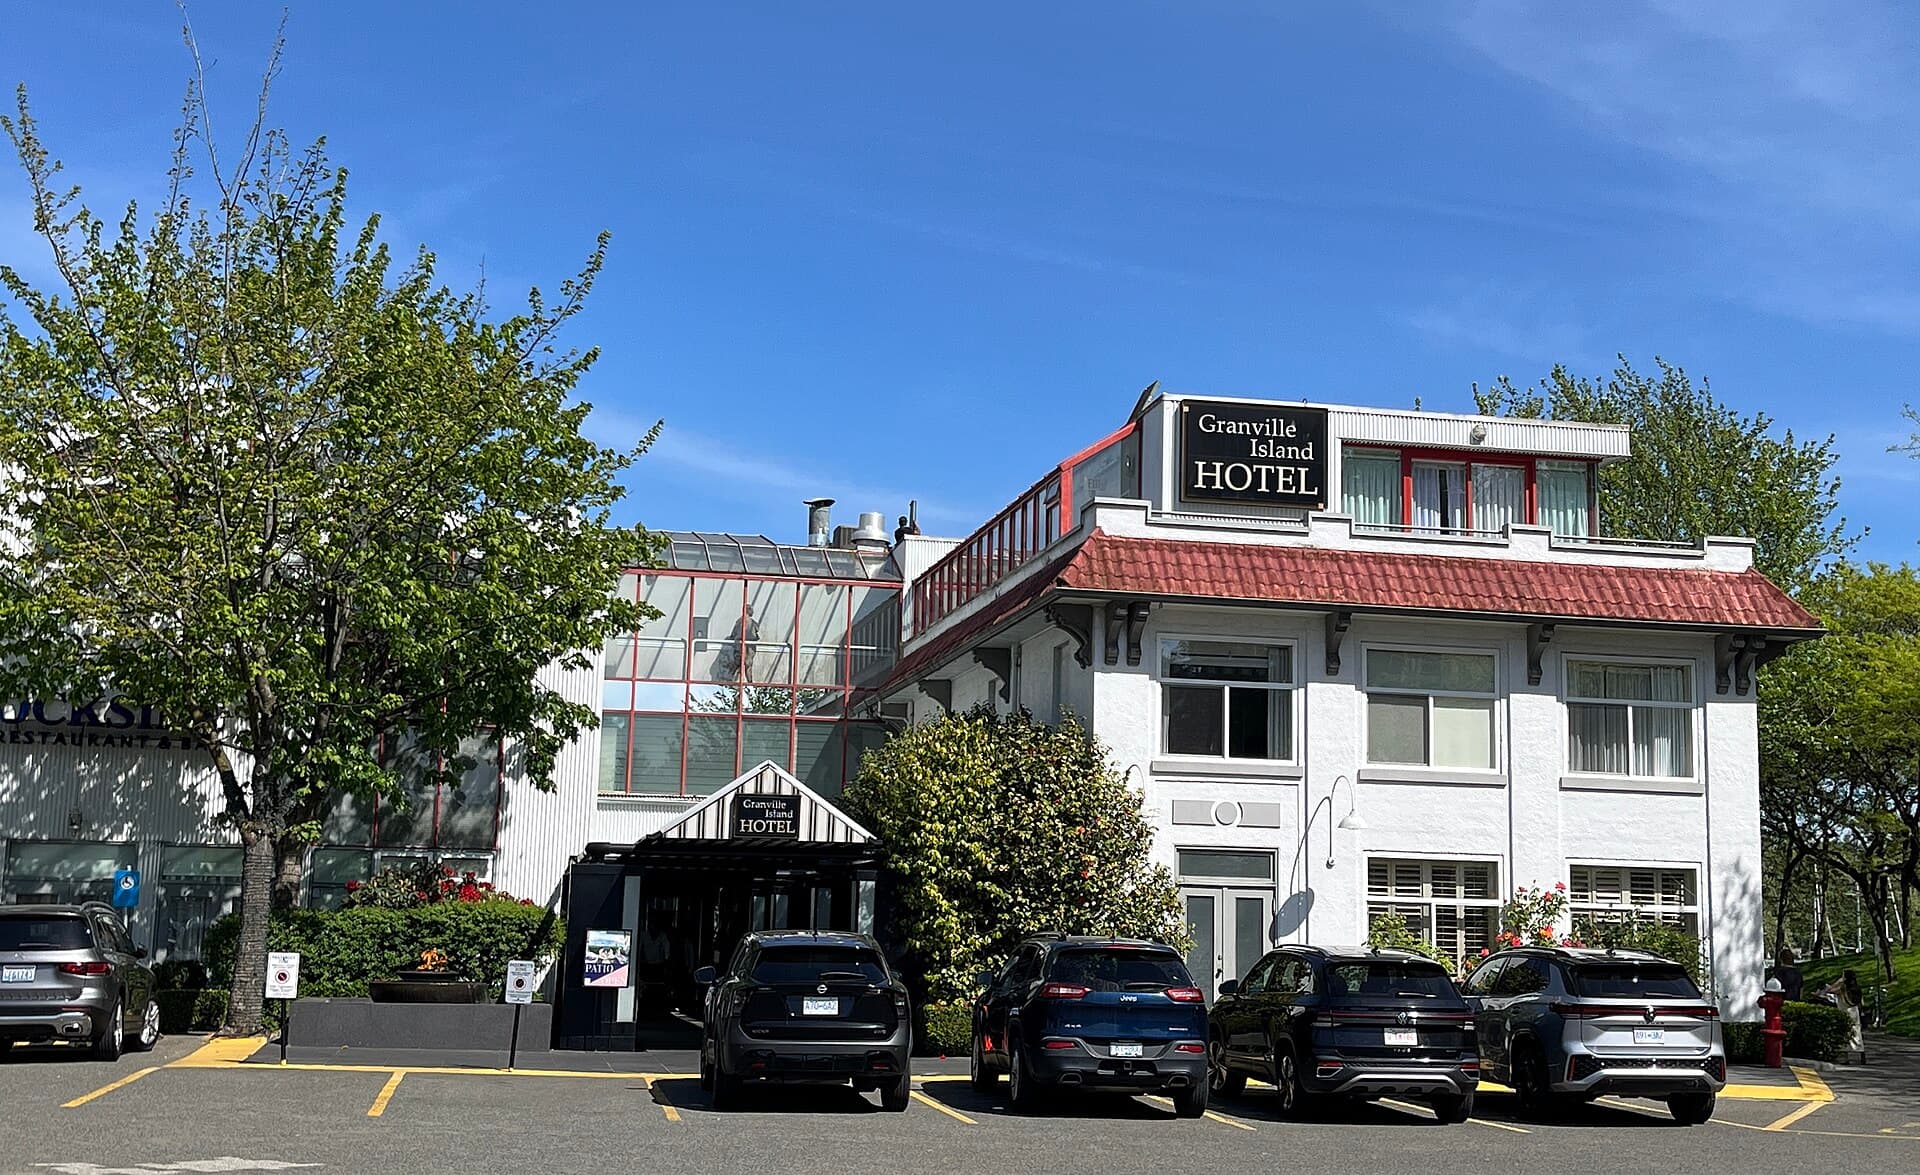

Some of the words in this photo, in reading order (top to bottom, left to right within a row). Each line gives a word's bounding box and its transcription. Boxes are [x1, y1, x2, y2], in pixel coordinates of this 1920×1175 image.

[1198, 413, 1297, 438] Granville
[1249, 438, 1315, 461] Island
[1193, 460, 1319, 496] HOTEL
[157, 736, 171, 750] &
[743, 799, 787, 809] Granville
[764, 808, 794, 819] Island
[739, 819, 796, 833] HOTEL
[585, 963, 615, 974] PATIO
[1120, 994, 1138, 1002] Jeep
